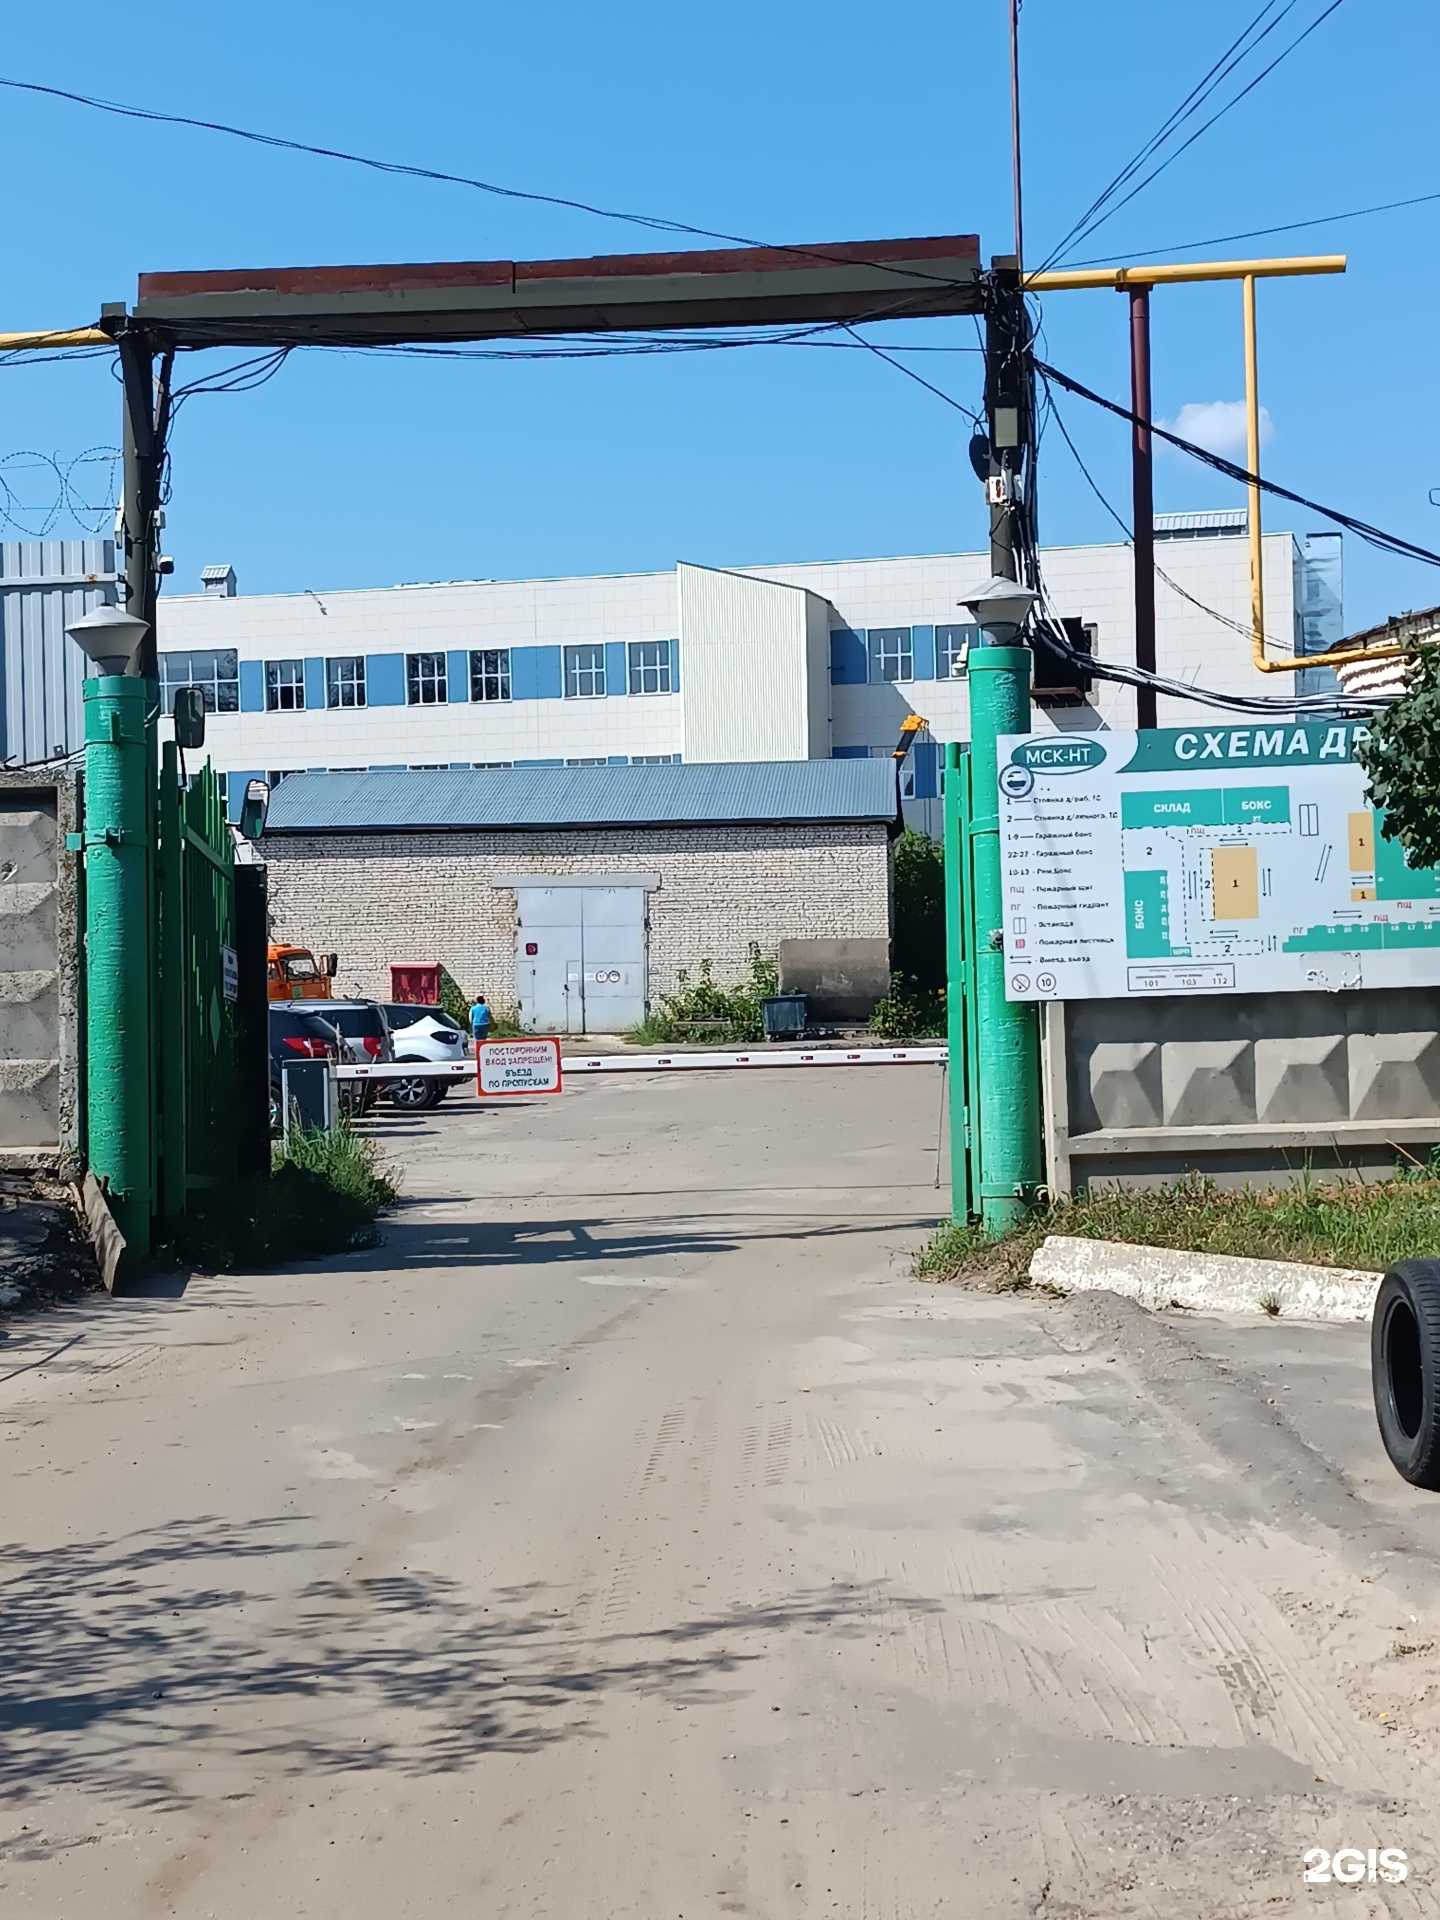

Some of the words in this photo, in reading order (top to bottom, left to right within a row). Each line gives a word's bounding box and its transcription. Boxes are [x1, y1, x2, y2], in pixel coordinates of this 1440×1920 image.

[1174, 729, 1310, 760] СХЕМА
[1025, 746, 1091, 765] МСК-НТ
[1153, 802, 1191, 814] СКЛАД
[1241, 800, 1272, 810] БОКС
[1358, 837, 1365, 847] 1
[1146, 846, 1153, 856] 2
[1204, 880, 1211, 889] 2
[1232, 879, 1239, 888] 1
[1360, 890, 1367, 899] 1
[1134, 899, 1145, 929] БОКС
[1224, 944, 1231, 953] 2
[1041, 978, 1052, 987] 10
[1212, 977, 1227, 985] 112
[485, 1058, 507, 1066] ВХОД
[505, 1068, 532, 1077] ВЪЕЗД
[489, 1080, 500, 1088] ПО
